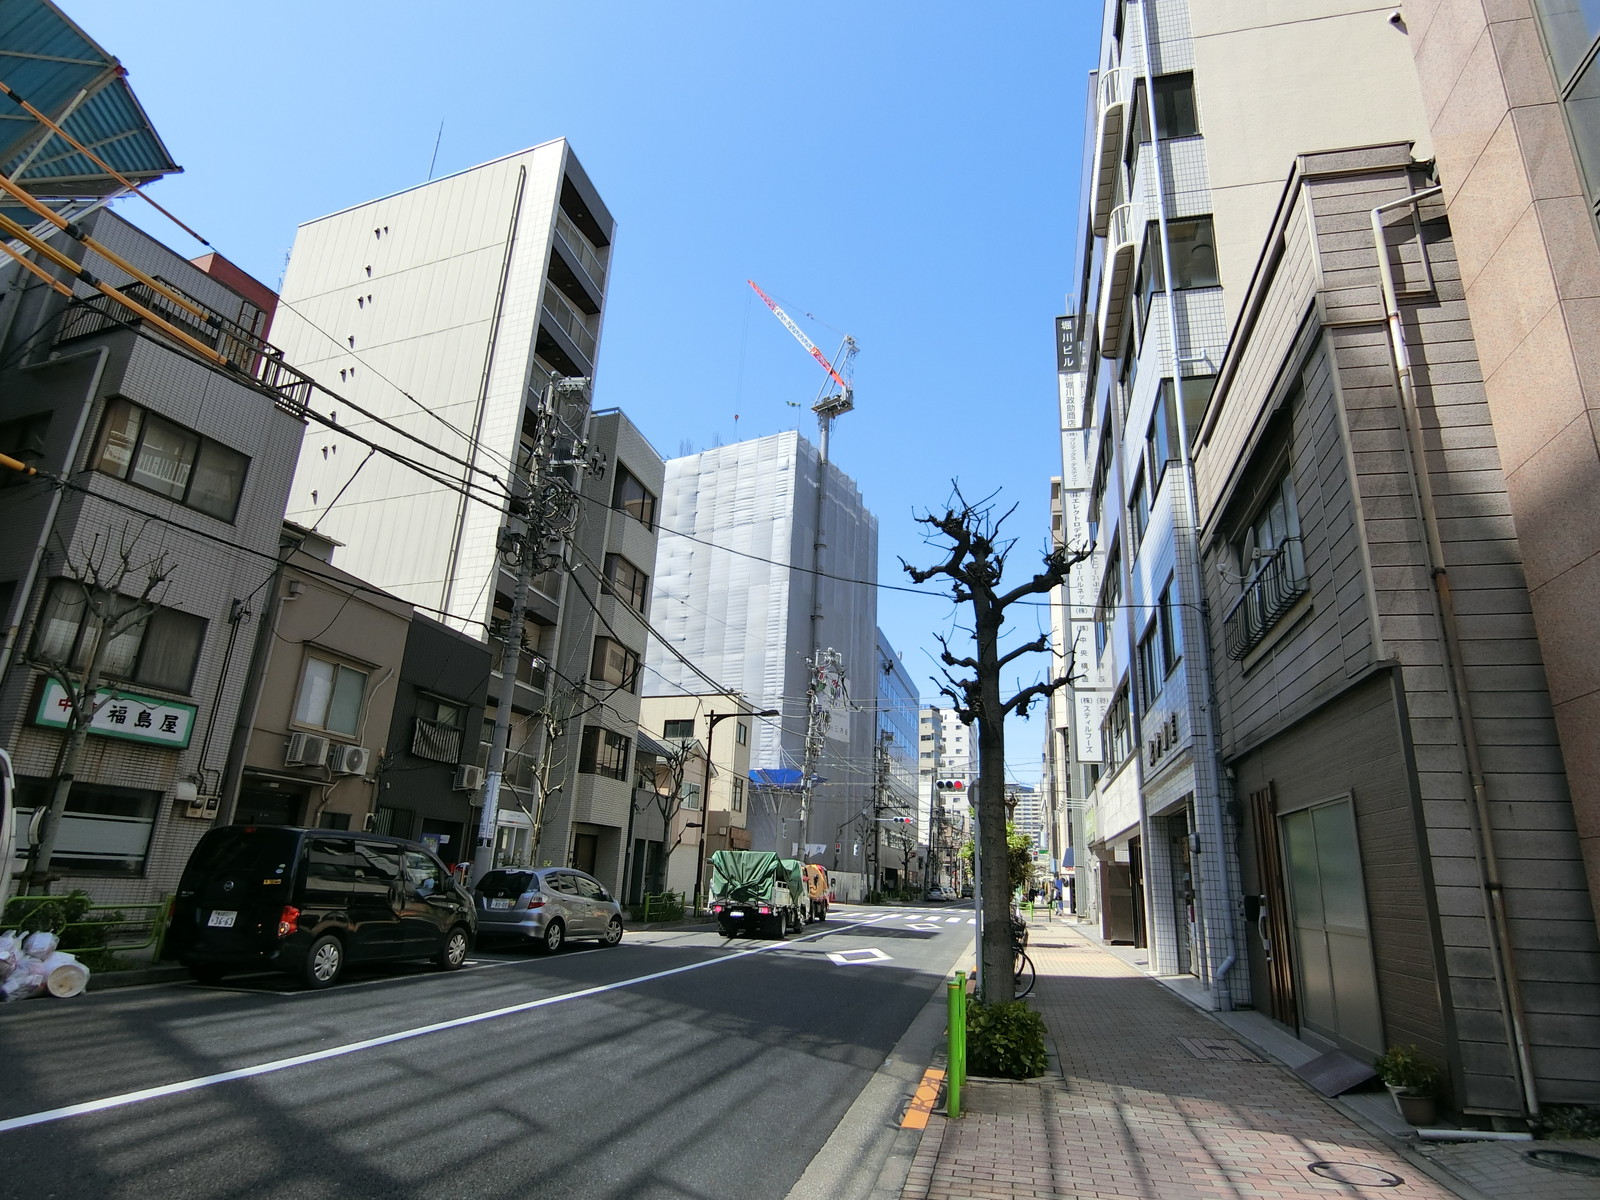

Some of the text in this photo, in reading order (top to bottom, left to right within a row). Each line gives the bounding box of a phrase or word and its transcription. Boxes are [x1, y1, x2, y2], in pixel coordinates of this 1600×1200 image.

[1061, 320, 1074, 367] 堀川ビル
[107, 705, 179, 734] 福島屋
[1080, 697, 1093, 754] (株)スティルフーズ
